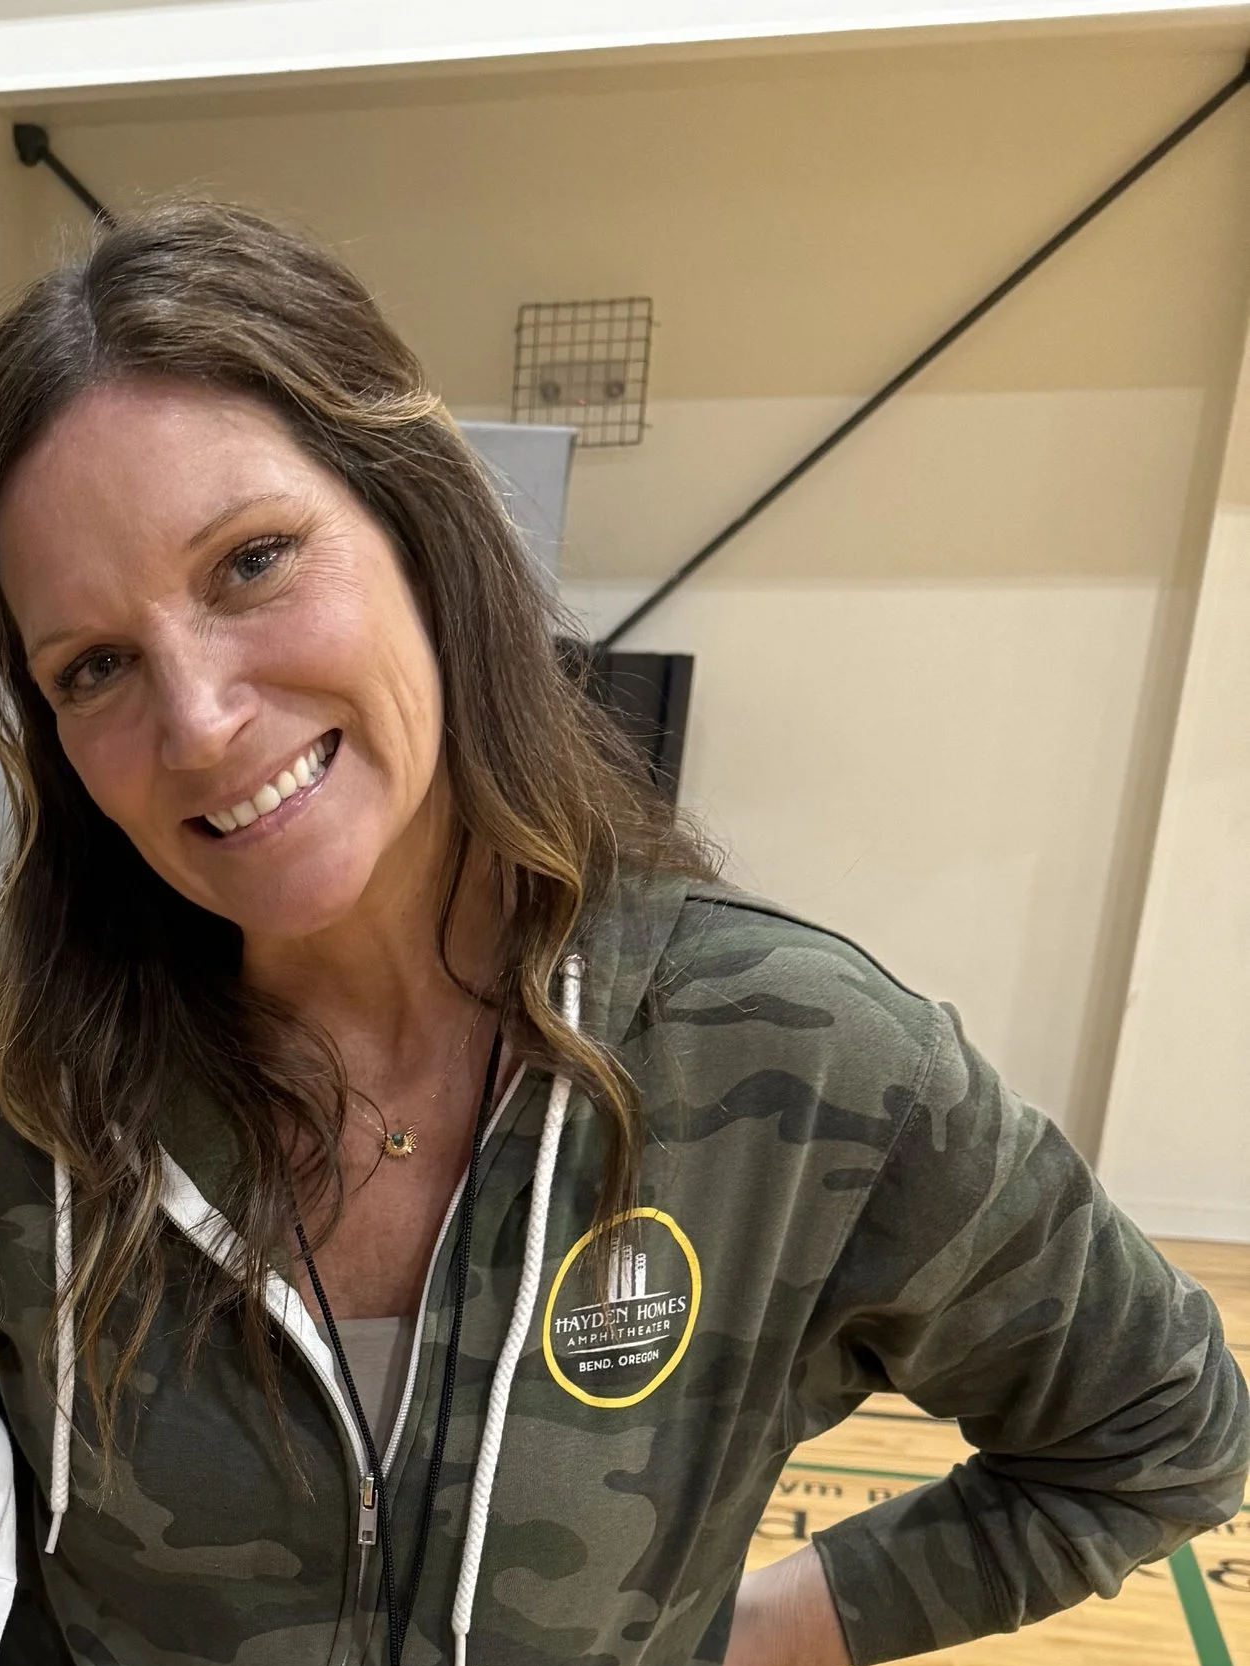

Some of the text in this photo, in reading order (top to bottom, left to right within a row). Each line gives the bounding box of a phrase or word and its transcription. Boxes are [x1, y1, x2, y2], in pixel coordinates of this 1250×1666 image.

[554, 1296, 687, 1334] HAYDEN HOMES
[567, 1319, 671, 1347] AMPHITHEATER
[618, 1349, 660, 1367] OREGON
